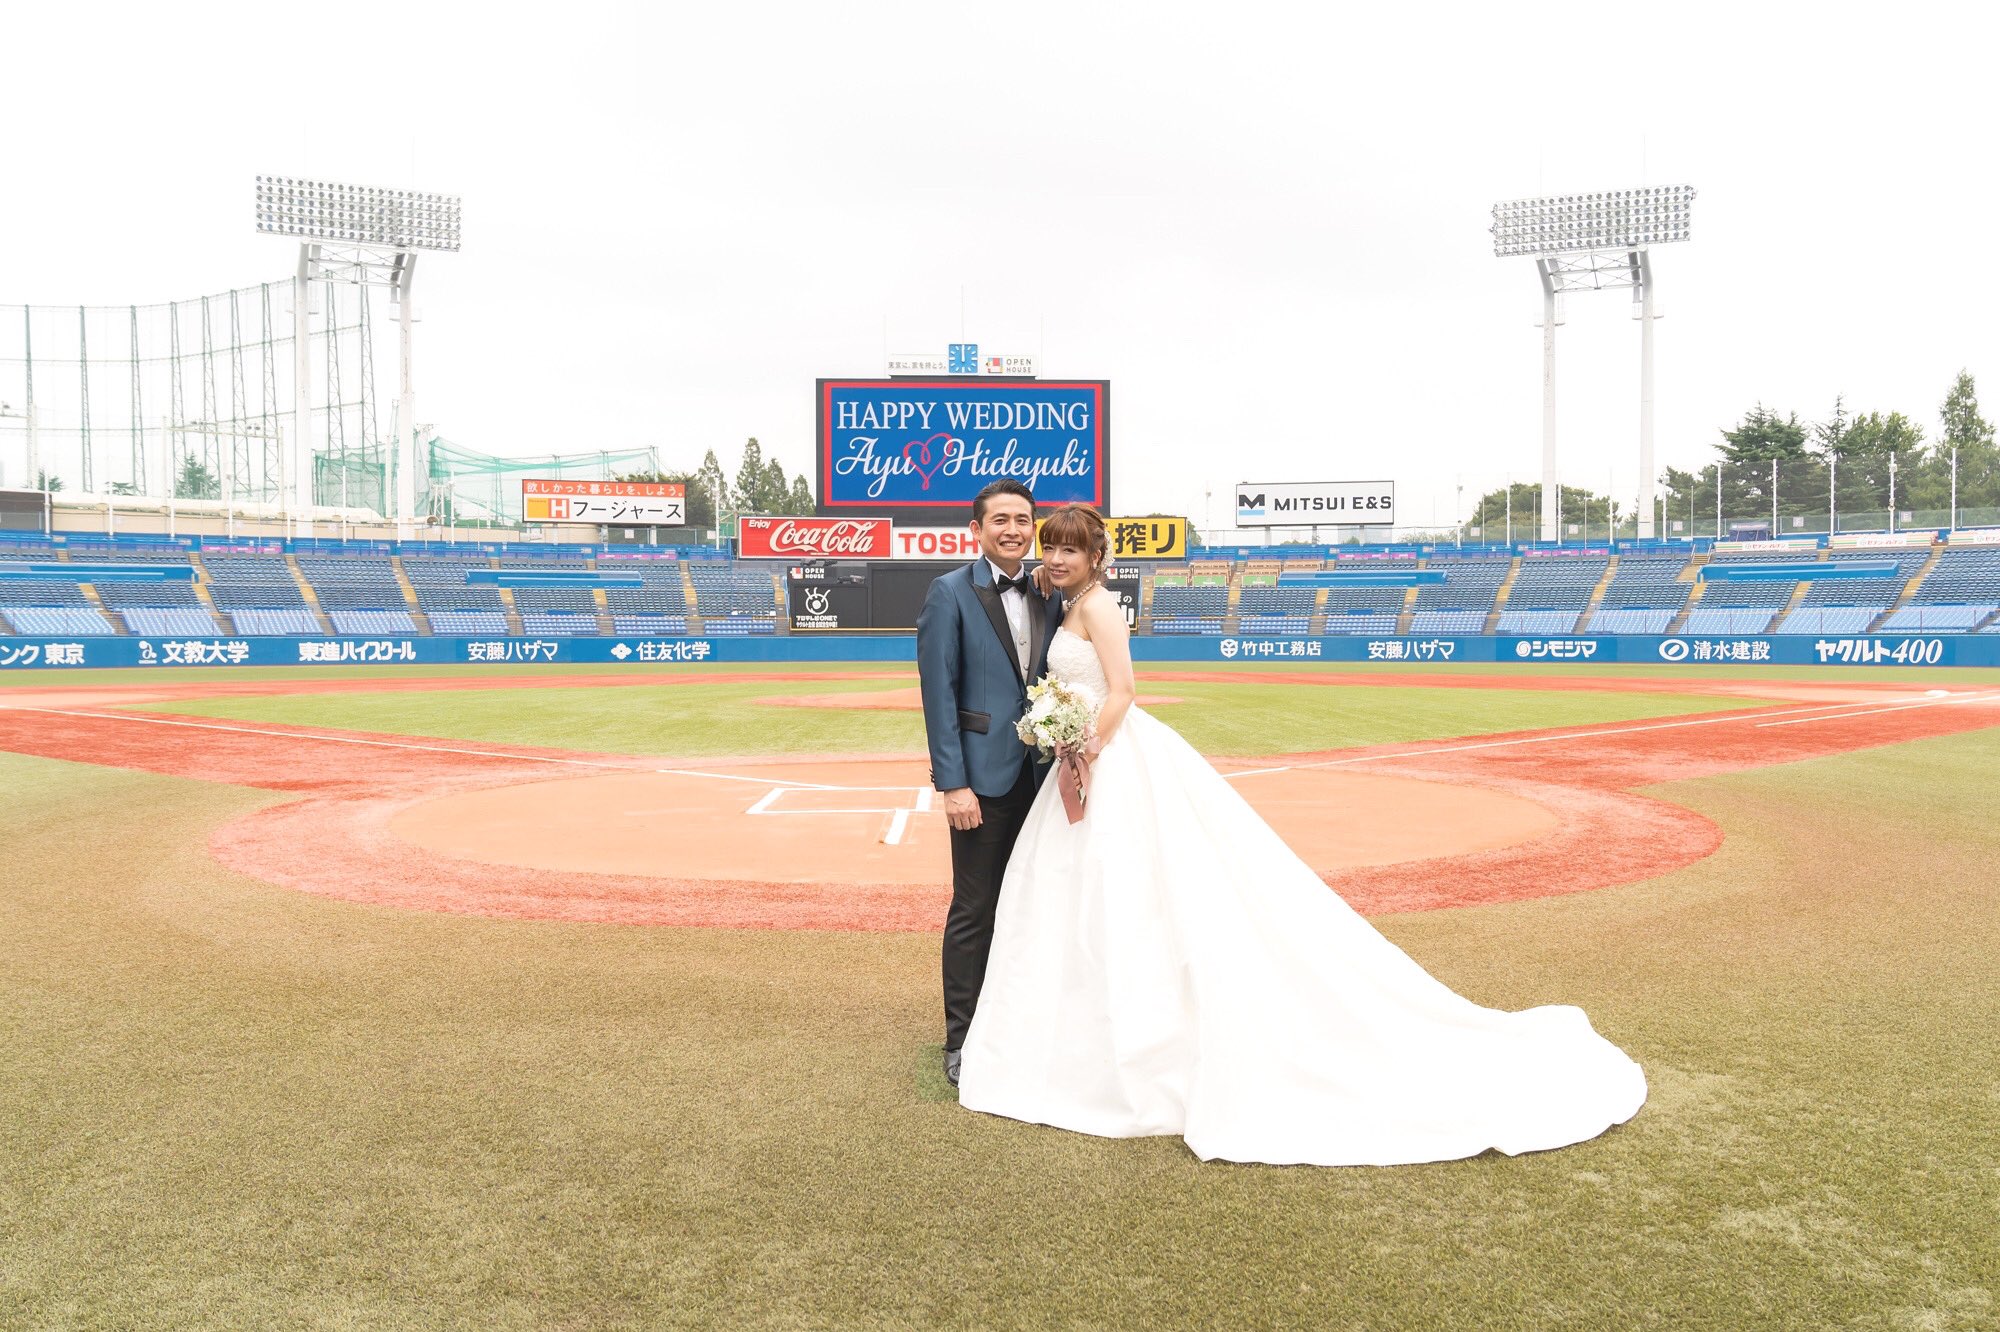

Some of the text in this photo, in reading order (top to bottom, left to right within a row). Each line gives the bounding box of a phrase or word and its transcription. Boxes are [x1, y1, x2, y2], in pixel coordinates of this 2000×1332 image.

[837, 401, 1090, 431] HAPPY WEDDING
[836, 436, 1091, 498] Ayu Hideyuki
[527, 483, 683, 497] 欲しかった暮らしを、しよう。
[573, 500, 682, 520] フージャース
[1274, 497, 1345, 511] MITSUI
[1352, 496, 1392, 510] E&S
[749, 519, 771, 529] Enjoy
[769, 520, 878, 553] Coca-Cola
[44, 643, 85, 665] 東京
[162, 641, 250, 664] 文教大学
[298, 641, 417, 661] 東進ハイスクール
[467, 639, 559, 661] 安藤ハザマ
[636, 641, 711, 661] 住友化学
[1241, 640, 1322, 657] 竹中工務店
[1367, 639, 1455, 659] 安藤ハザマ
[1532, 640, 1597, 658] シモジマ
[1693, 640, 1771, 661] 清水建設
[1815, 638, 1943, 664] ヤクルト400
